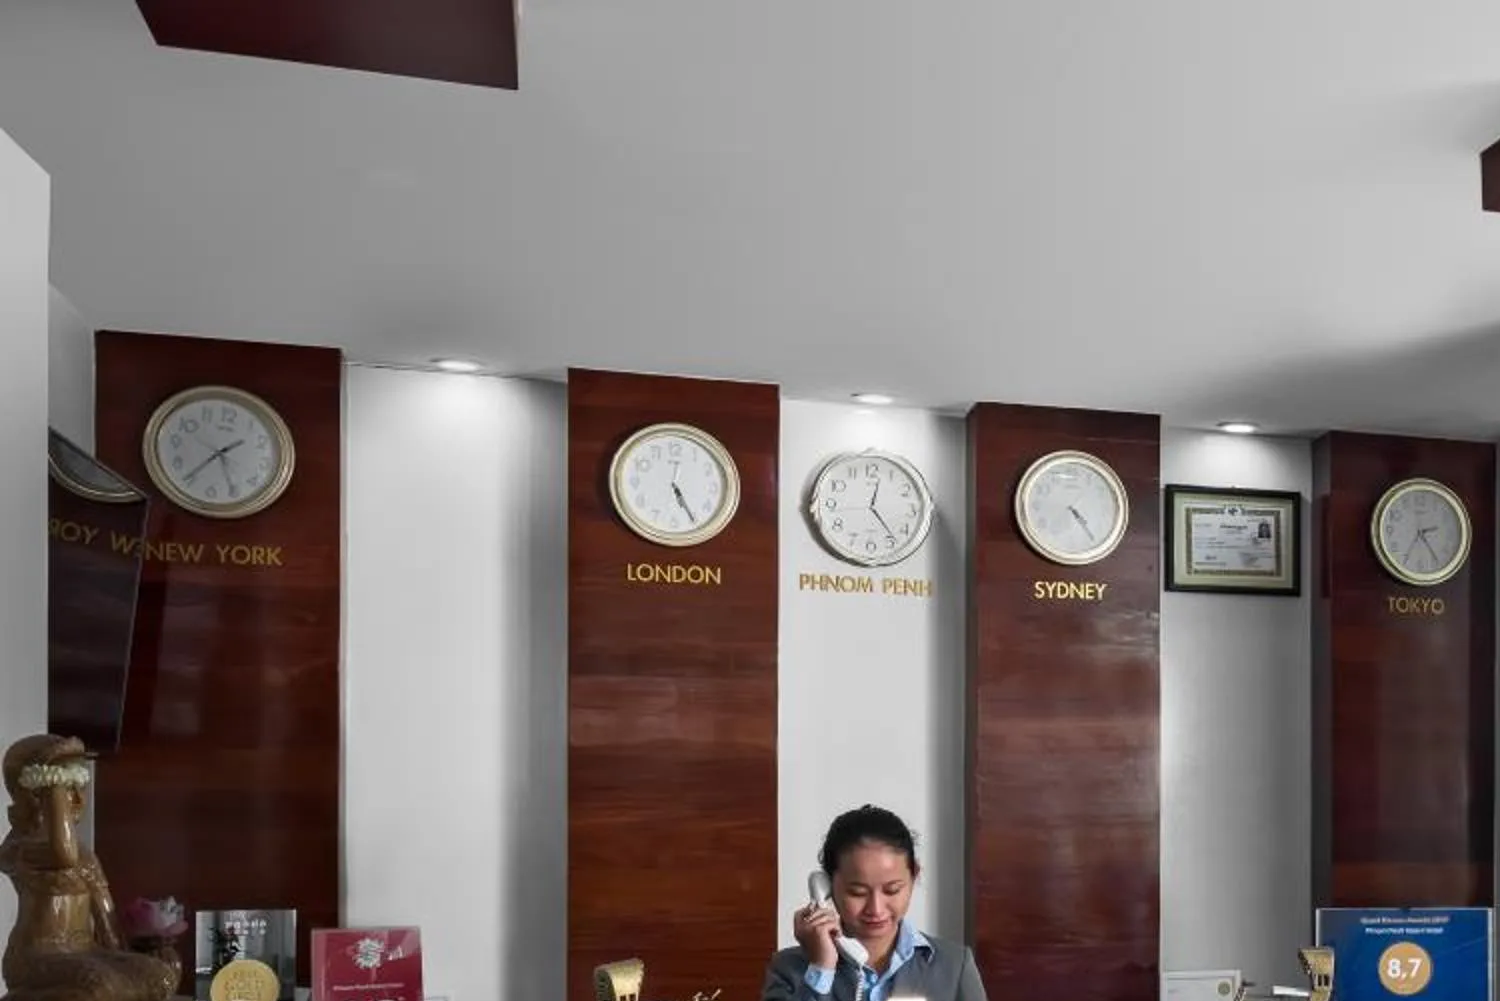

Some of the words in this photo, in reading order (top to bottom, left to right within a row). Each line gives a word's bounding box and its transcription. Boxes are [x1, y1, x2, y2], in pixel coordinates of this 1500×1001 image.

[865, 463, 879, 479] 12
[145, 542, 204, 563] NEW
[216, 544, 283, 566] YORK
[626, 563, 722, 585] LONDON
[799, 573, 874, 593] PHNOM
[882, 576, 933, 598] PENH
[1033, 581, 1109, 600] SYDNEY
[1388, 597, 1446, 615] TOKYO
